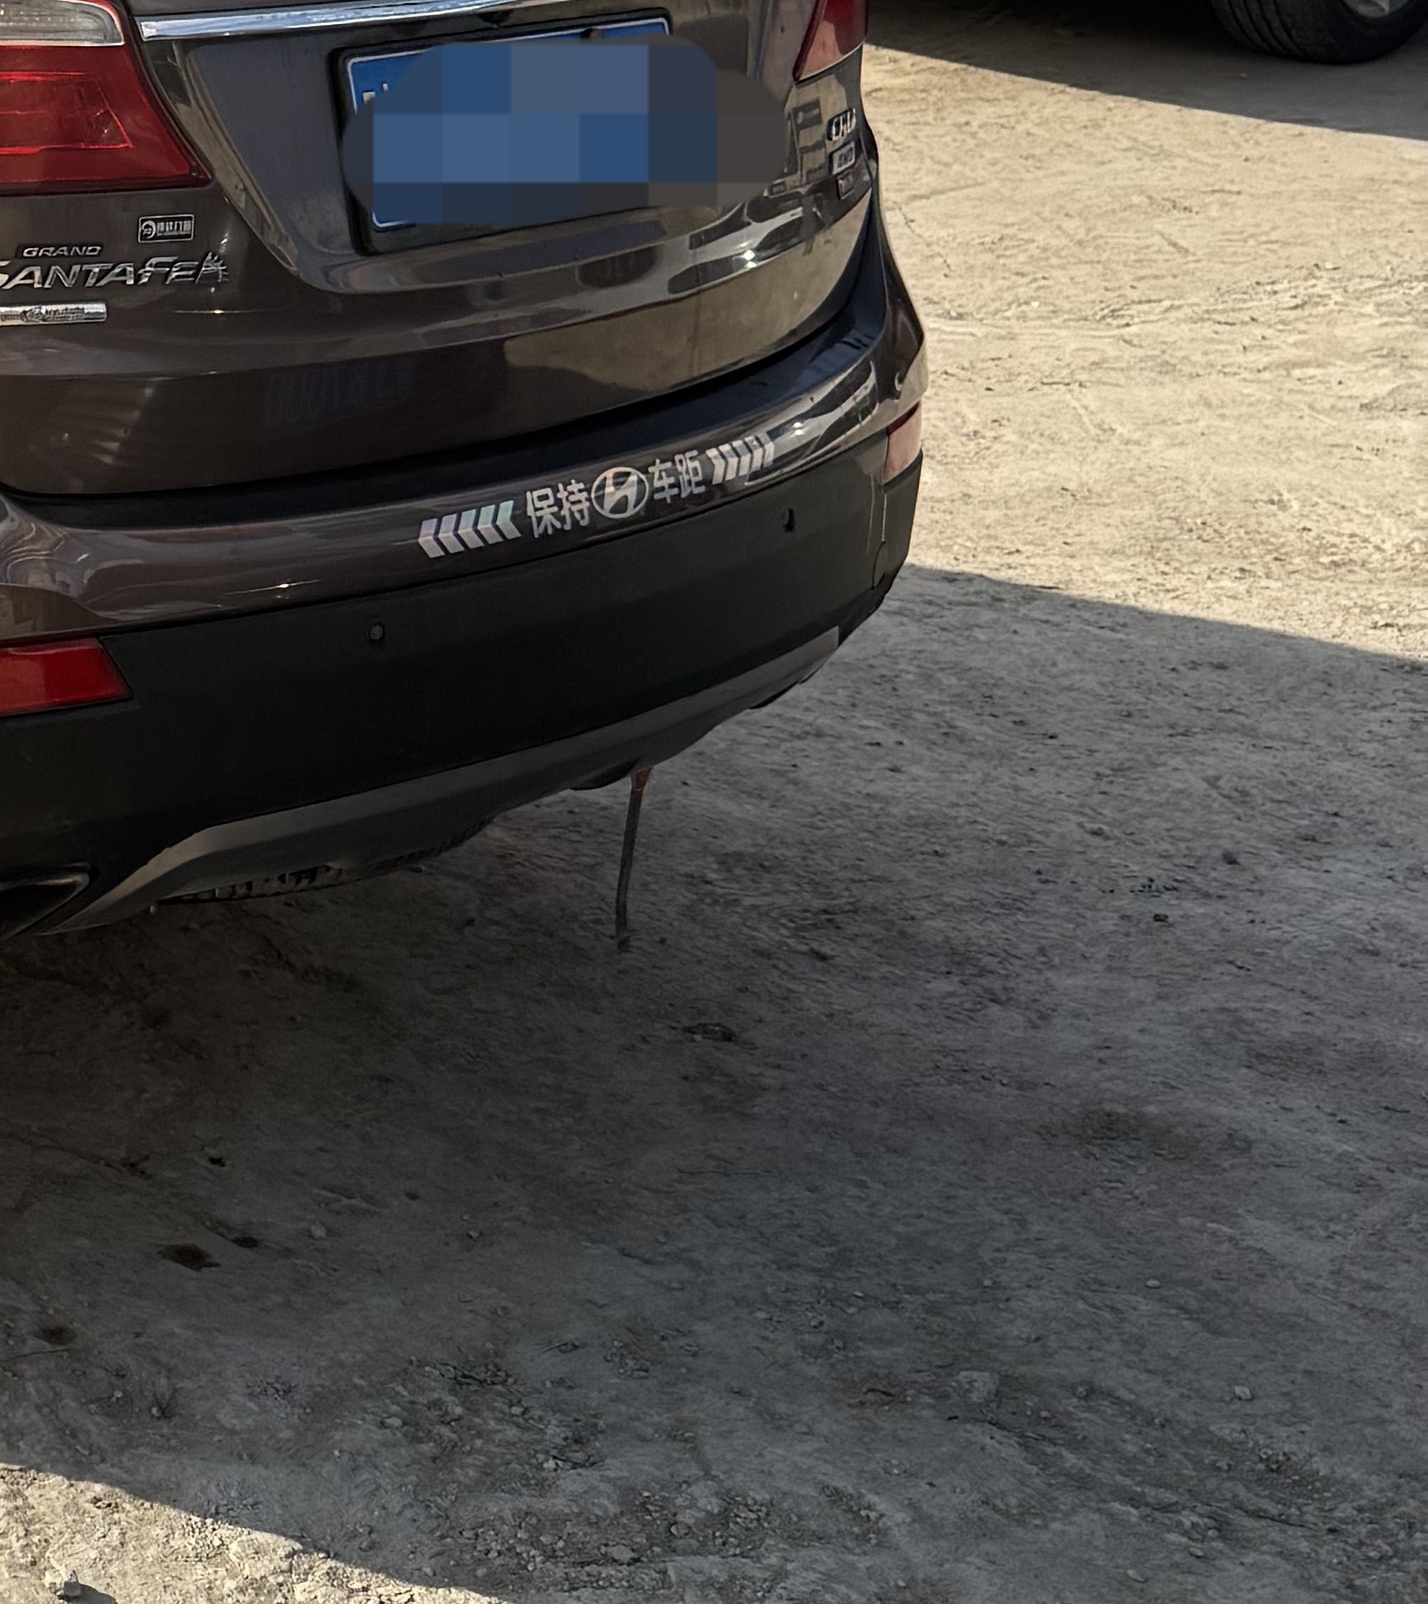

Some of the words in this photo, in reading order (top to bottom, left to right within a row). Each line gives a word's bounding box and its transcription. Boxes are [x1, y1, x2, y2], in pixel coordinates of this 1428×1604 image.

[22, 245, 102, 257] GRAND
[525, 477, 591, 538] 保持
[648, 449, 707, 504] 车距
